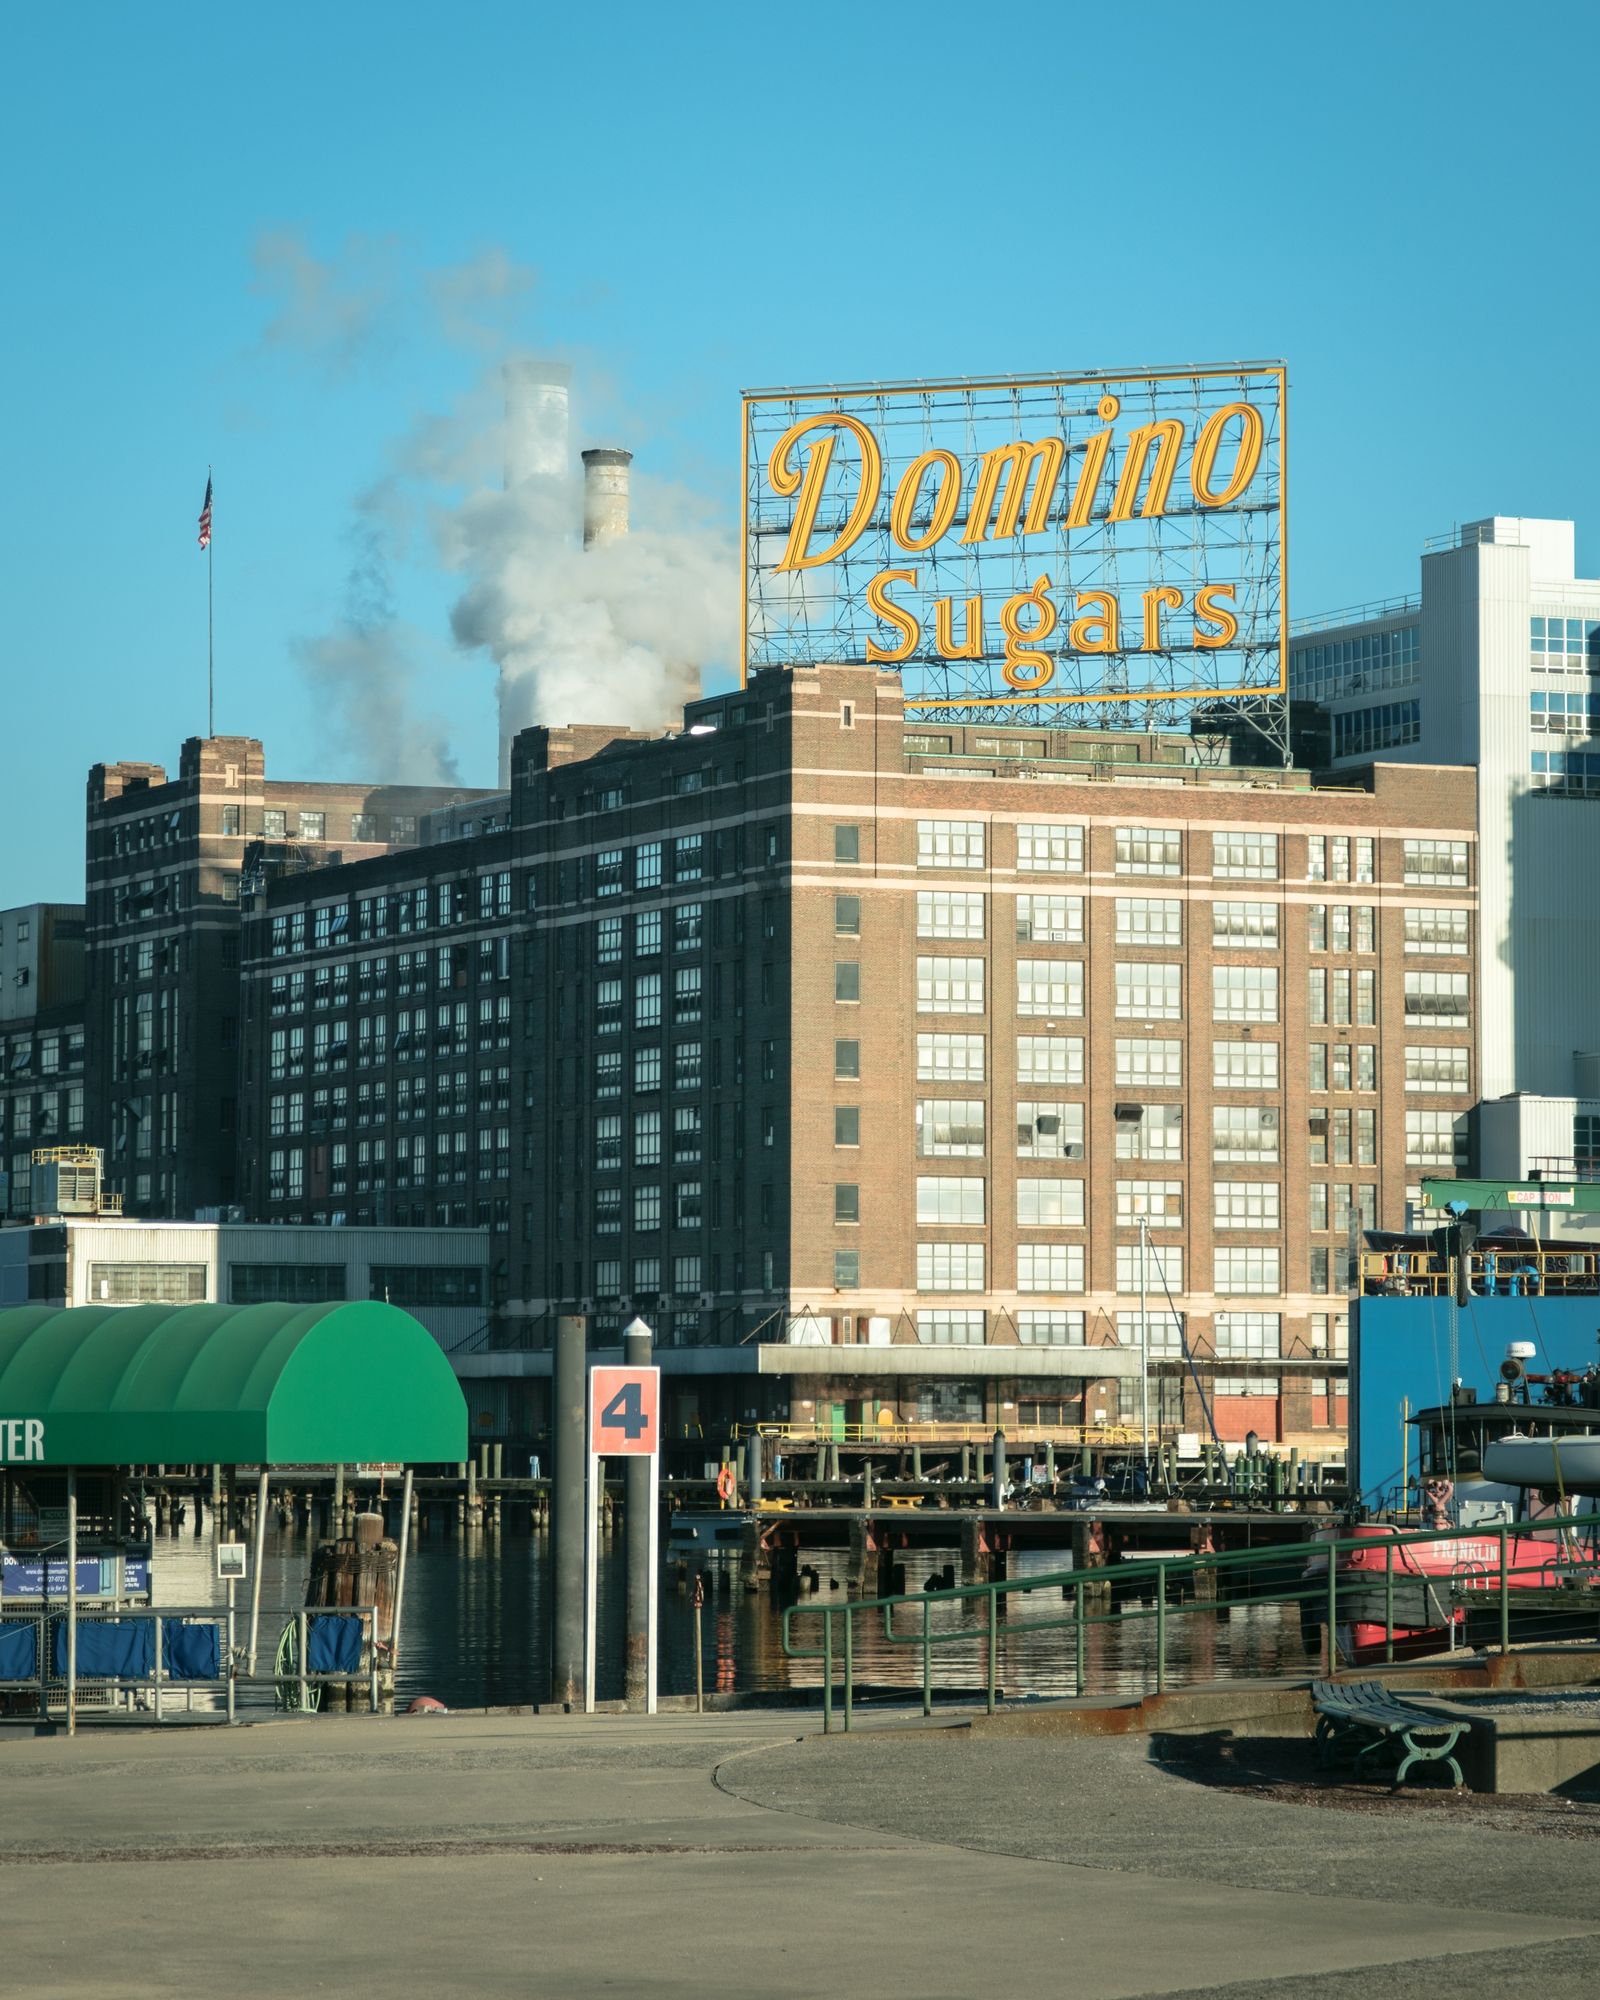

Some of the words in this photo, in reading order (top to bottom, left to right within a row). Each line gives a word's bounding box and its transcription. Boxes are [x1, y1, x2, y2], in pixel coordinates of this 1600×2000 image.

[768, 394, 1263, 573] Domino
[866, 568, 1239, 690] Sugars
[1517, 1192, 1535, 1202] CAP
[601, 1383, 648, 1439] 4
[1432, 1540, 1498, 1562] FRANKLIN
